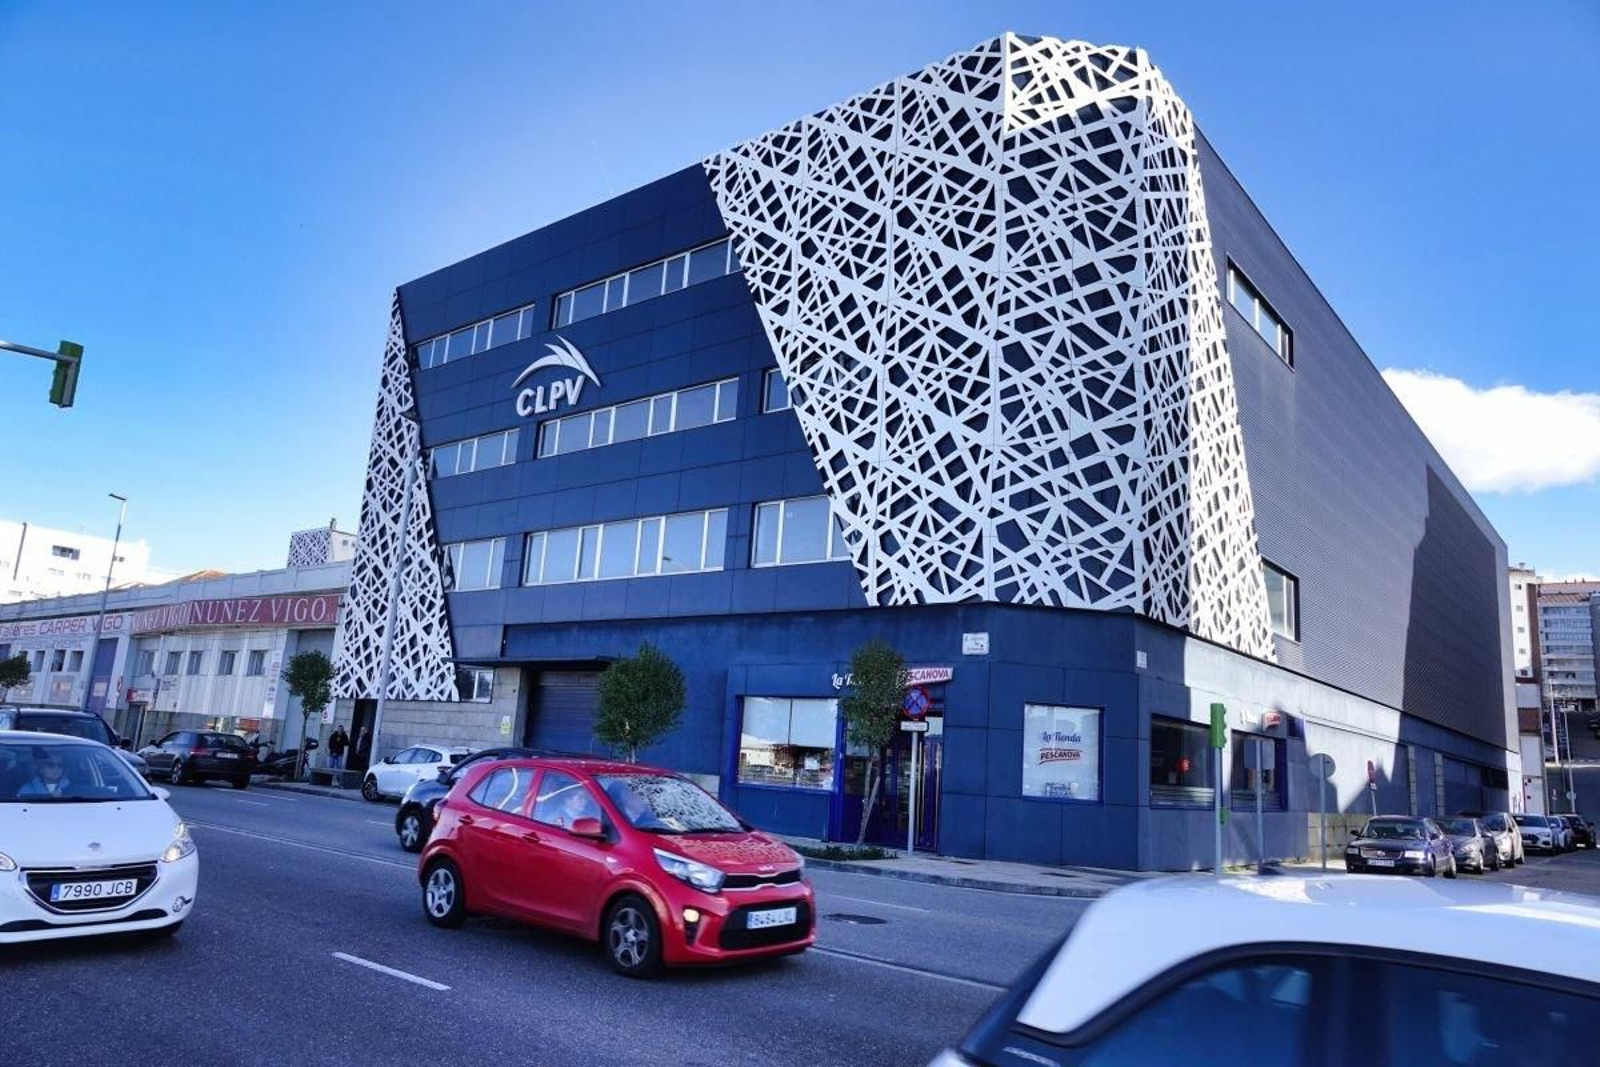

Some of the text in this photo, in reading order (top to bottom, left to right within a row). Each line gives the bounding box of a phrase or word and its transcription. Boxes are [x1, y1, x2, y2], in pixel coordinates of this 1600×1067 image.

[516, 374, 585, 417] CLPV
[271, 597, 326, 622] VIGO
[93, 615, 123, 632] VGO
[1040, 751, 1080, 760] PESCANOVA
[63, 881, 133, 898] 7990 JCB
